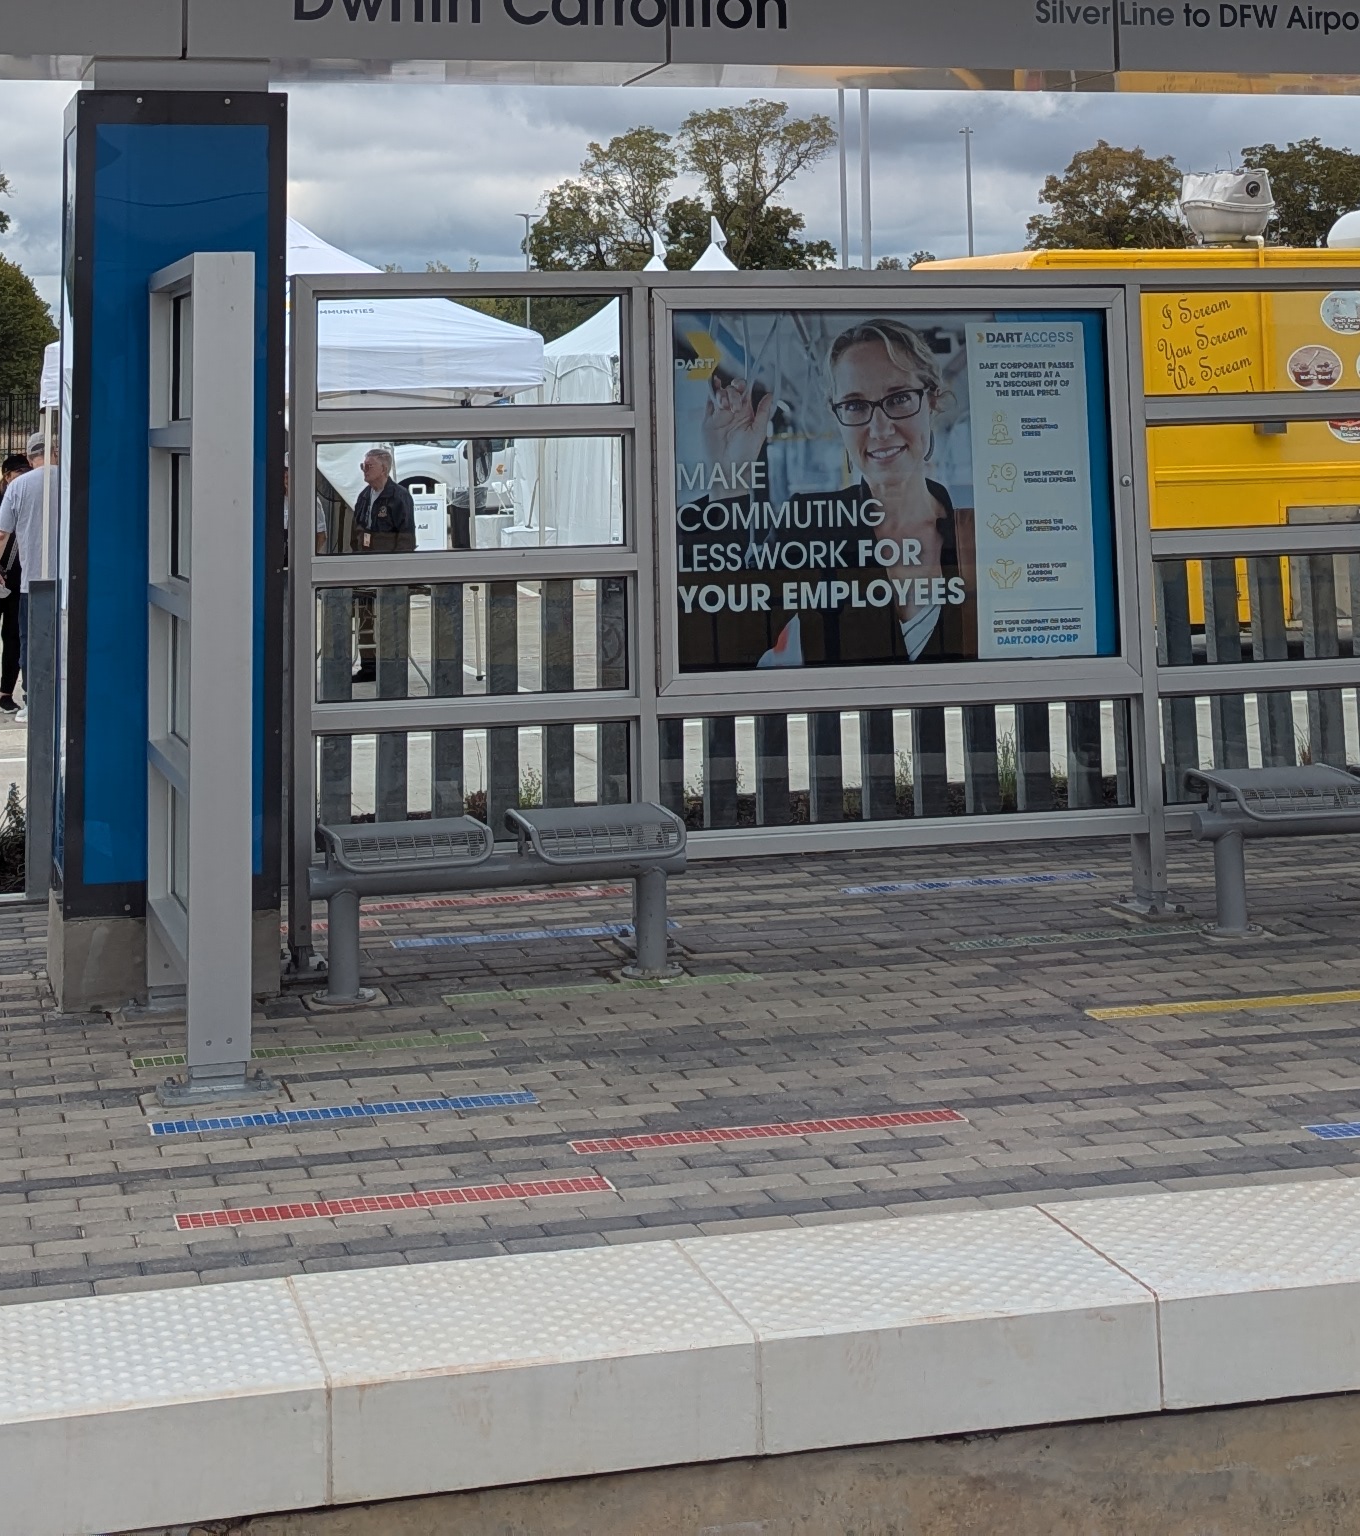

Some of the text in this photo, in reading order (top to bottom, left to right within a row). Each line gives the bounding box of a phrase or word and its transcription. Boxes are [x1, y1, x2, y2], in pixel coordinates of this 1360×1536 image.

[1035, 0, 1110, 26] Silver
[1119, 1, 1175, 27] Line
[1183, 3, 1211, 29] to
[1219, 4, 1278, 30] DFW
[1177, 297, 1231, 324] Scream
[1157, 324, 1248, 368] You Scream
[674, 358, 715, 370] DART
[994, 371, 1008, 379] ARE
[1048, 361, 1074, 369] PASSES
[1167, 363, 1197, 391] We
[1198, 356, 1253, 382] Scream
[1011, 389, 1036, 397] RETAIL
[676, 461, 766, 491] MAKE
[677, 499, 886, 532] COMMUTING
[678, 538, 922, 573] LESS WORK FOR
[678, 576, 966, 615] YOUR EMPLOYEES
[997, 634, 1079, 645] DART.ORG/CORP
